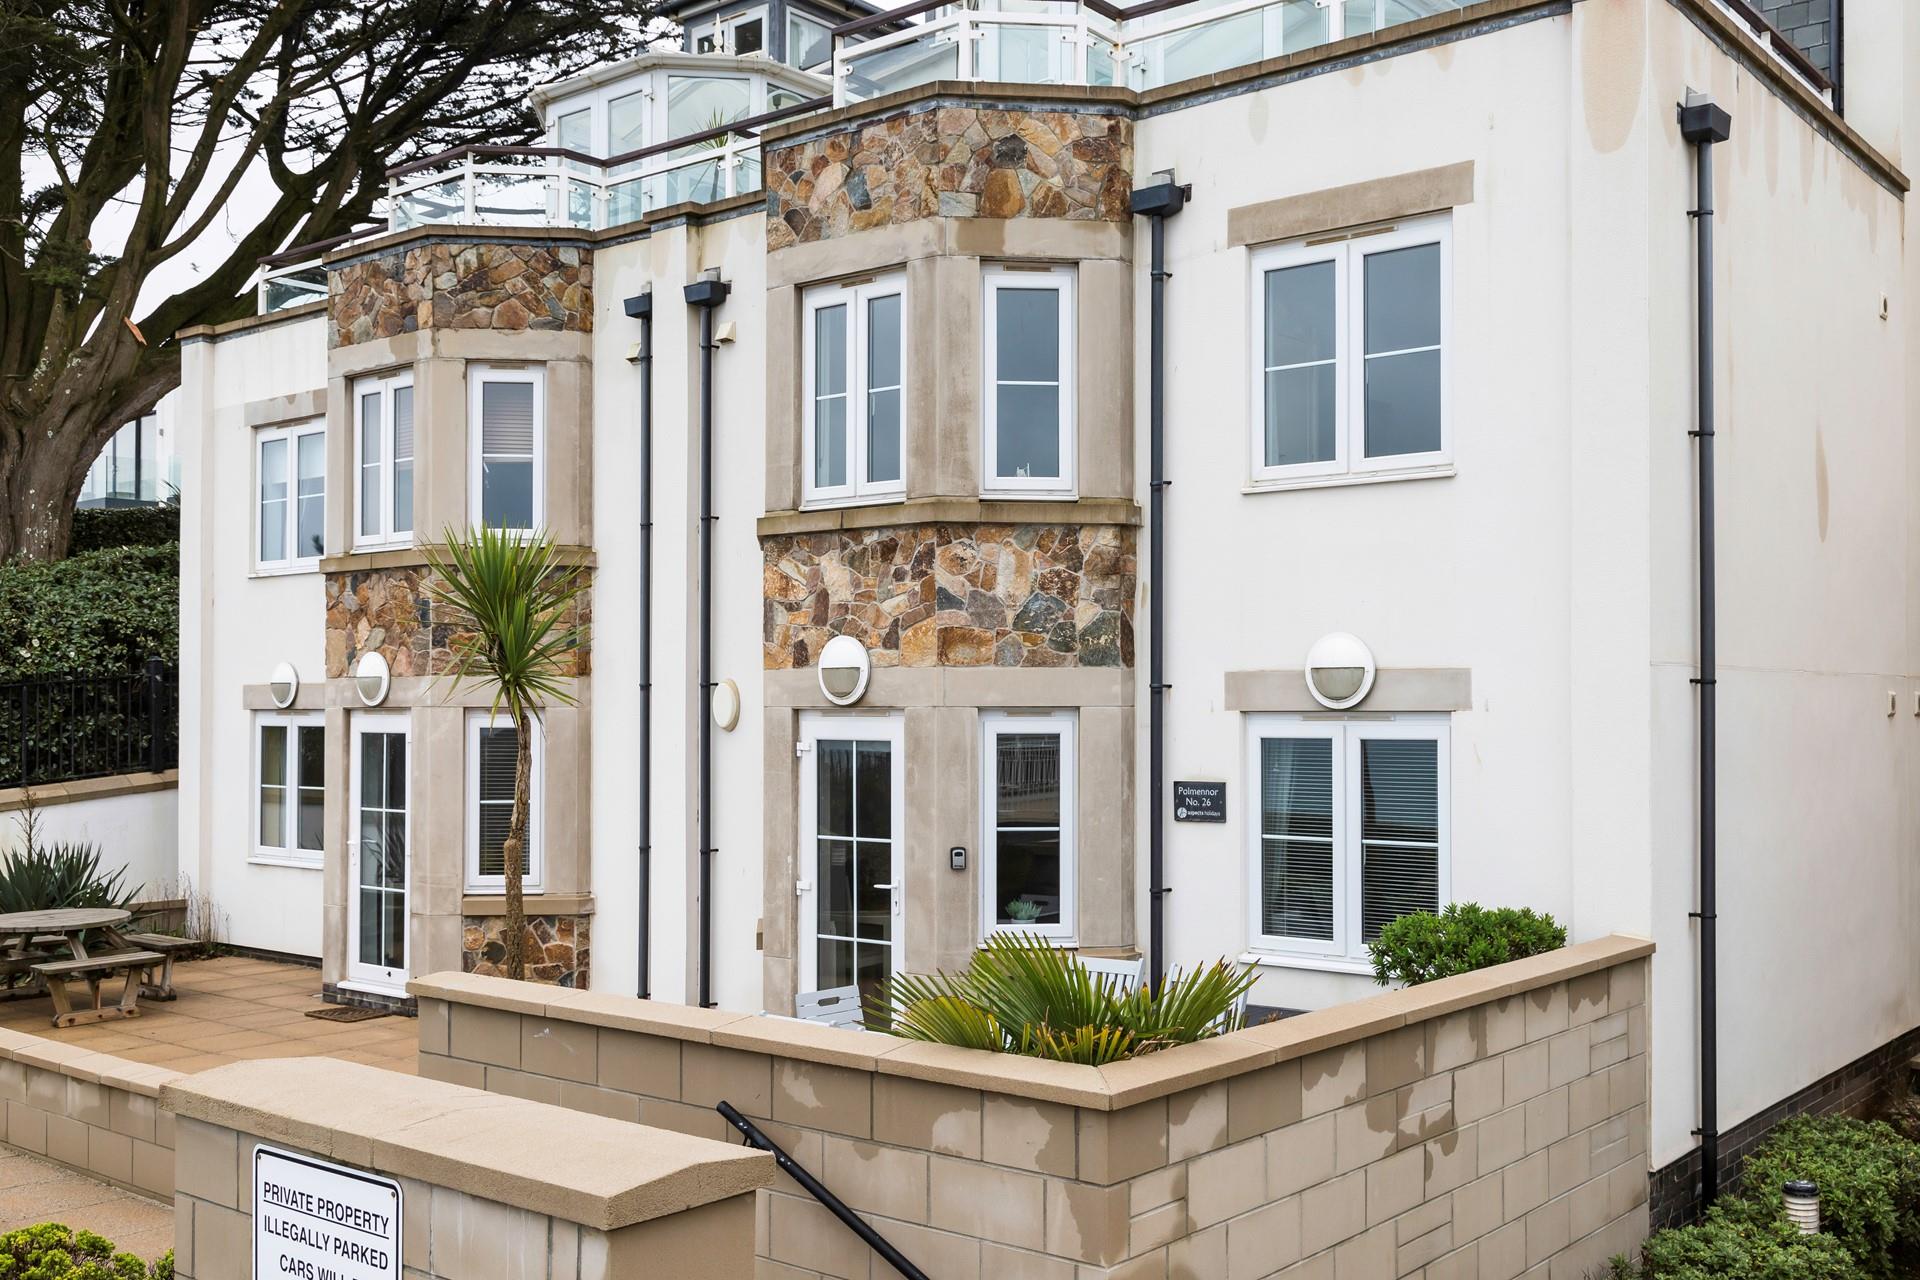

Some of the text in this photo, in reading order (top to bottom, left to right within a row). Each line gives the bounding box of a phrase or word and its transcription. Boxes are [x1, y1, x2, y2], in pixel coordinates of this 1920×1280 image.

[1185, 797, 1212, 807] No. 26
[264, 1181, 389, 1235] PRIVATE PROPERTY
[264, 1214, 389, 1271] ILLEGALLY PARKED
[279, 1254, 314, 1280] CARS
